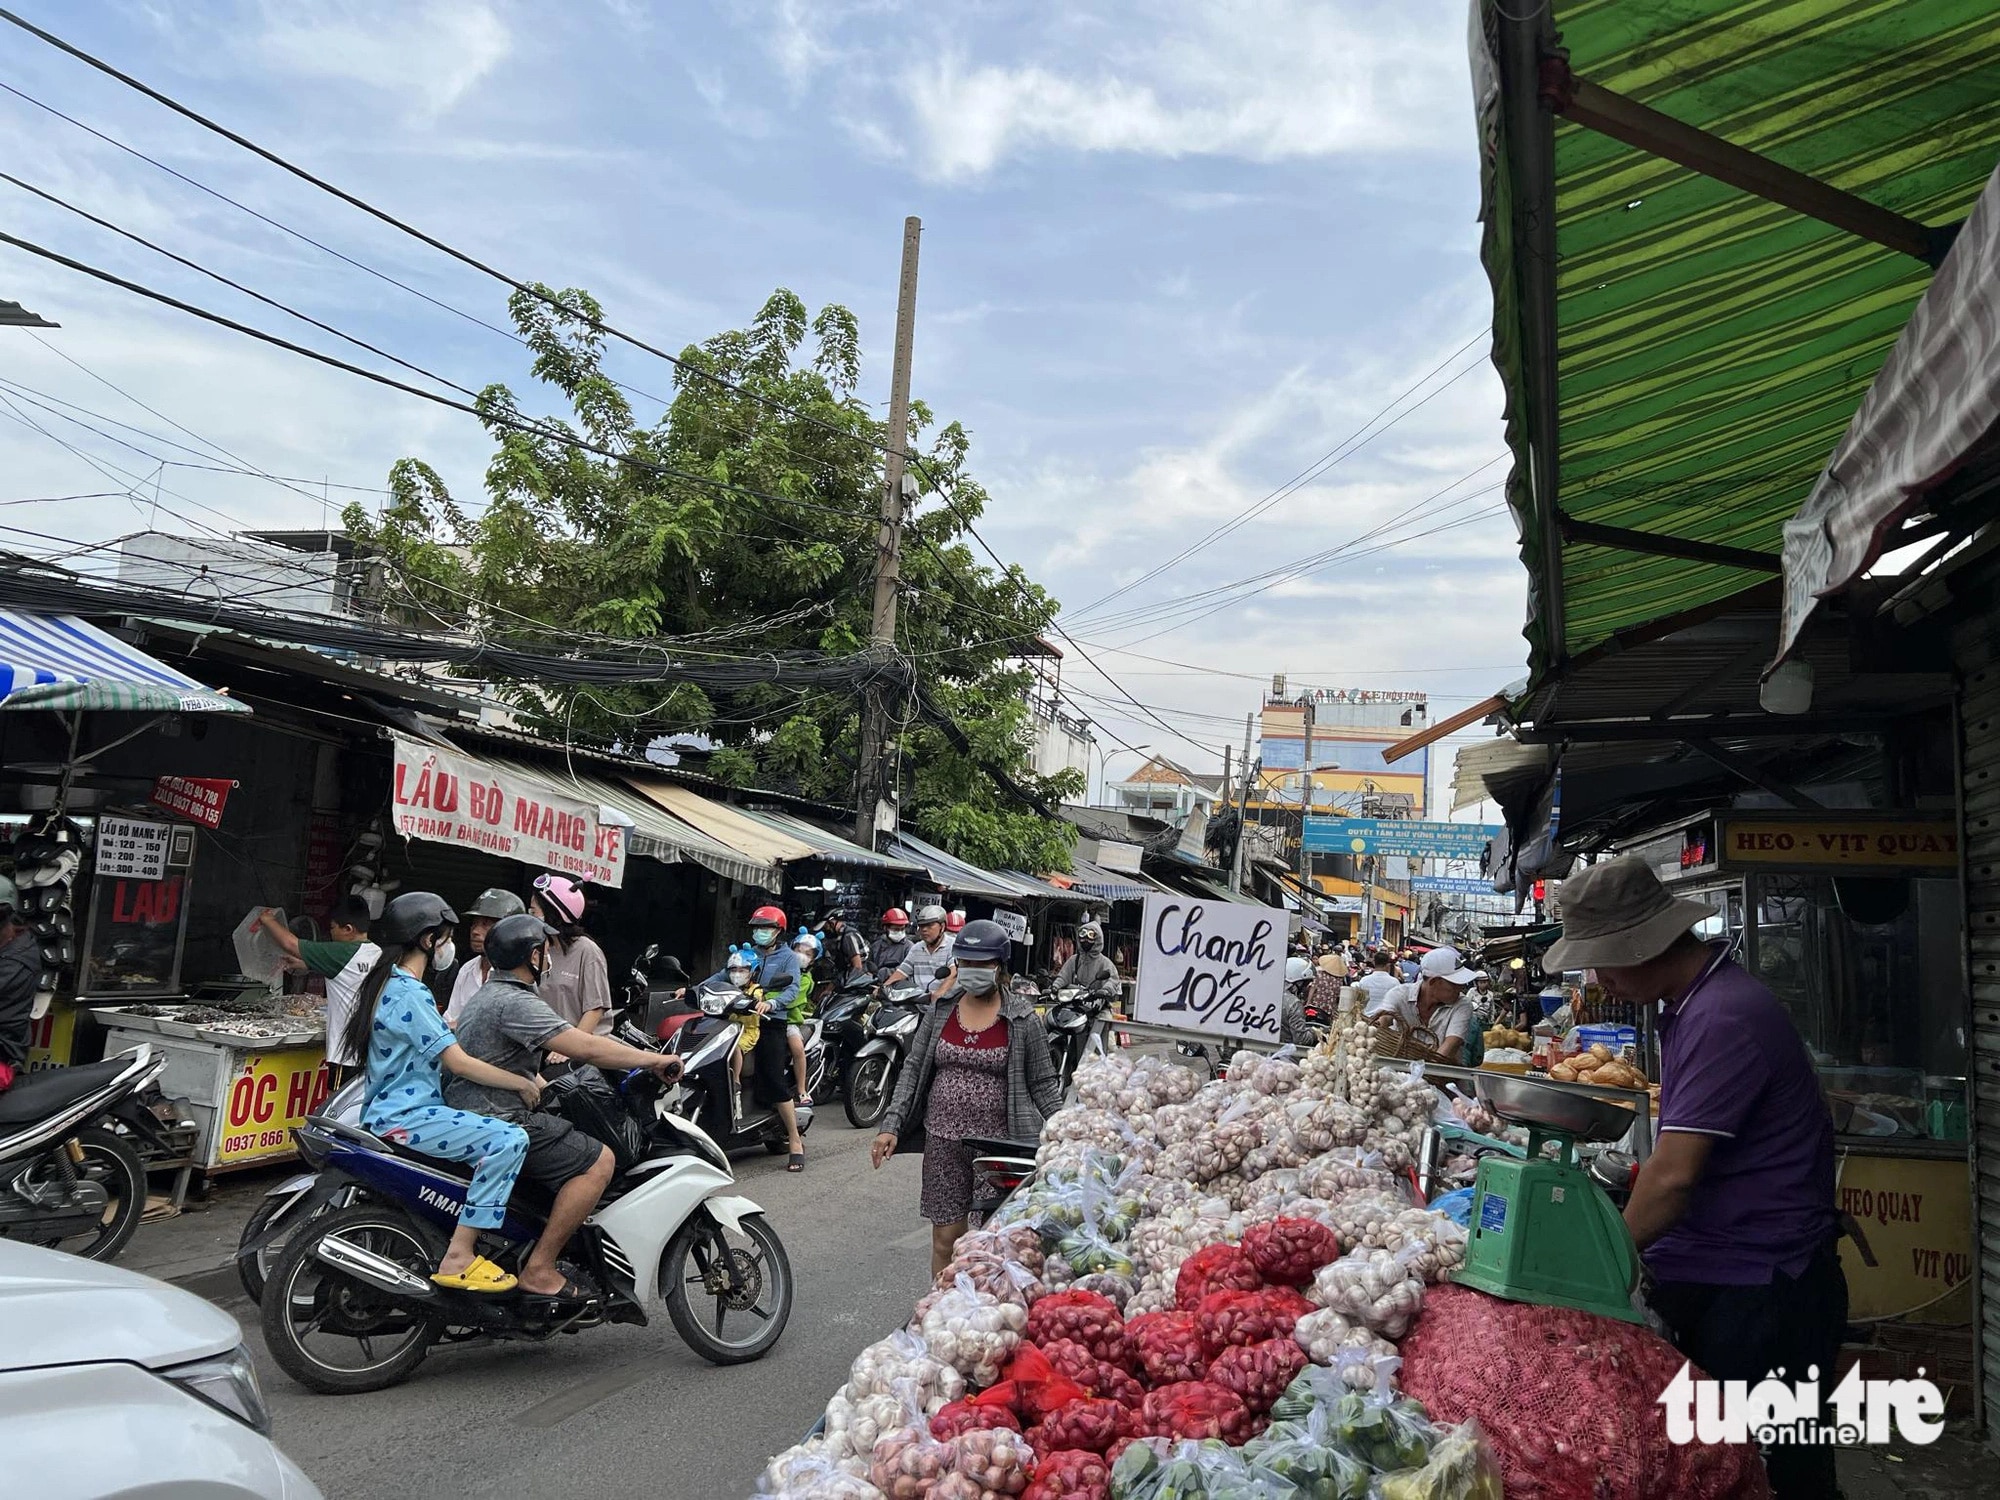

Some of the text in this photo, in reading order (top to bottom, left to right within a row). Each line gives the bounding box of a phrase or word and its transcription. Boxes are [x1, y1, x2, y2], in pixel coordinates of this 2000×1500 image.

[395, 754, 459, 813] LẨU
[469, 780, 504, 825] BÒ
[513, 796, 586, 852] MANG
[205, 807, 219, 824] 155
[118, 823, 129, 837] BÒ
[131, 826, 156, 839] MANG
[418, 817, 452, 838] PHẠM
[120, 839, 135, 849] 120
[145, 842, 161, 852] 150
[1737, 832, 1794, 850] HEO
[118, 852, 134, 861] 200
[143, 854, 160, 864] 250
[1378, 847, 1411, 856] CHU
[117, 864, 133, 874] 300
[142, 866, 158, 876] 400
[563, 854, 584, 873] 0939
[1156, 904, 1275, 970] Chanh
[230, 1057, 278, 1127] ỐC
[225, 1133, 257, 1153] 0937
[260, 1130, 283, 1147] 866
[1841, 1187, 1923, 1226] HEO QUAY
